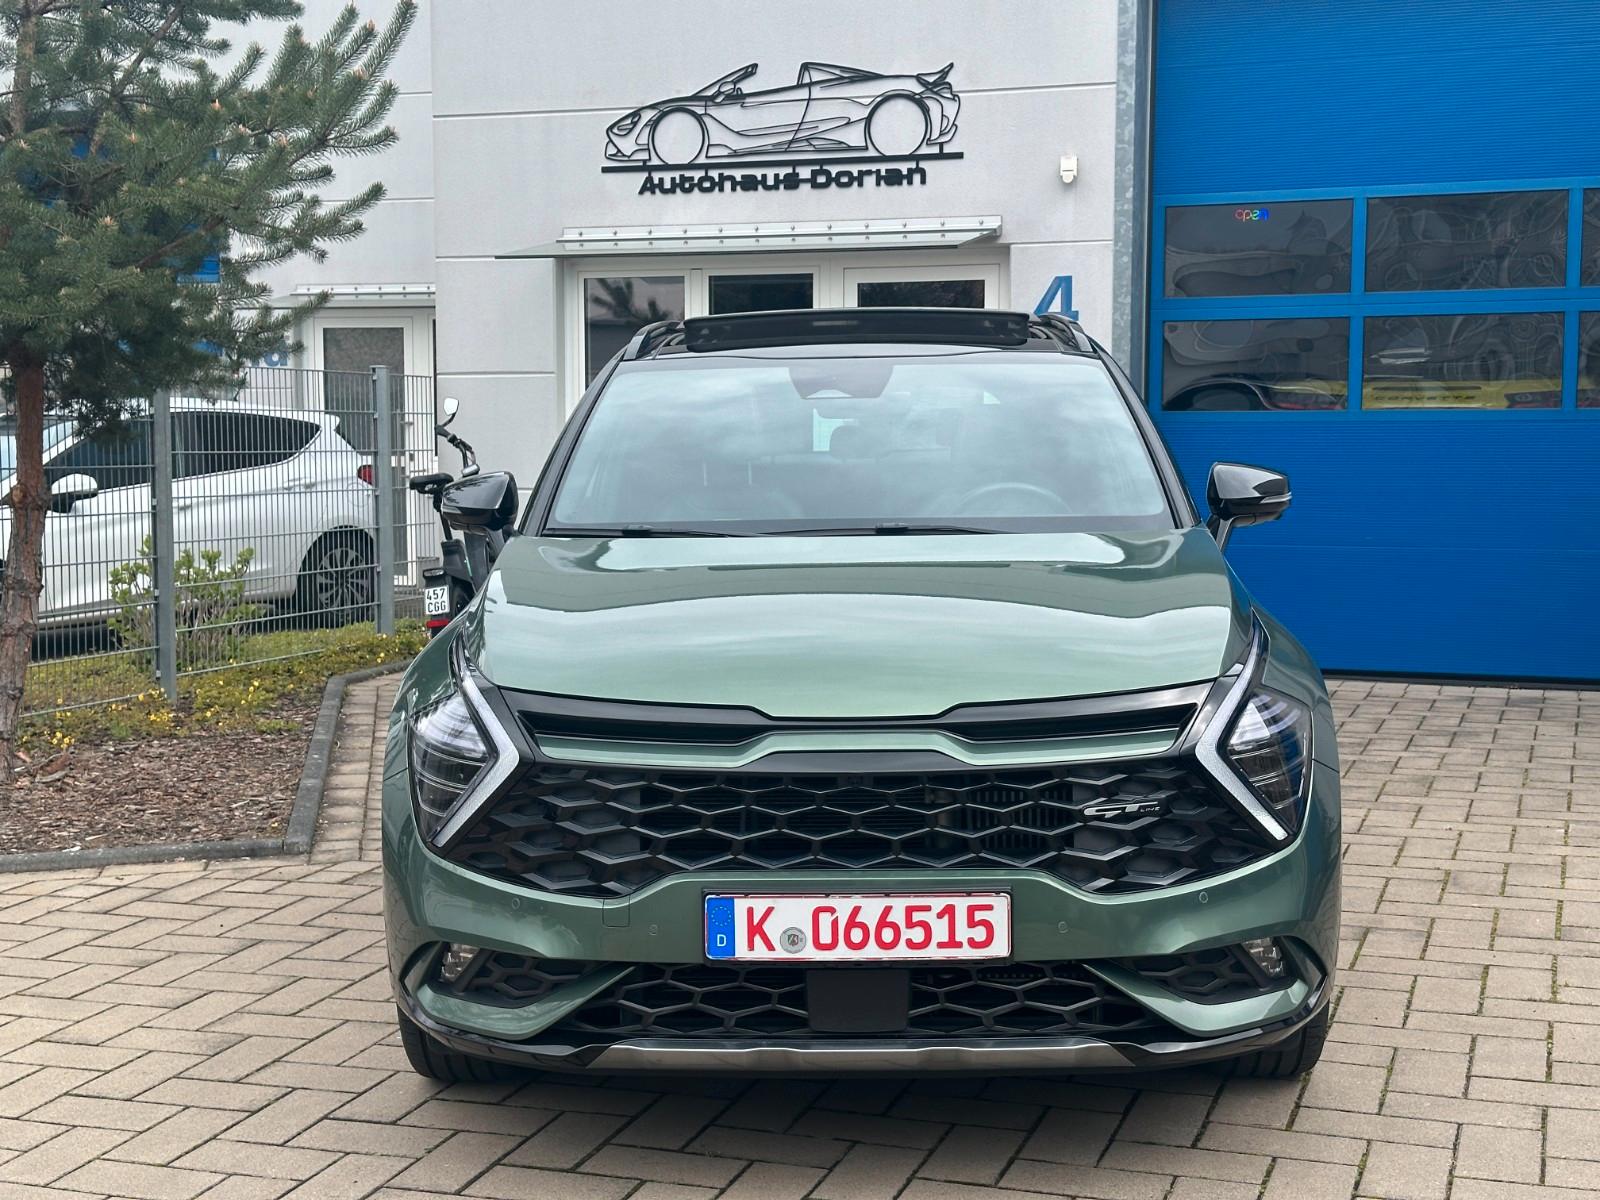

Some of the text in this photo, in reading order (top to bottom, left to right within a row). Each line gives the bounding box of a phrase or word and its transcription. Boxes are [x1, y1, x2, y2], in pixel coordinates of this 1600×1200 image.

[1234, 207, 1269, 222] open
[1033, 275, 1079, 321] 4
[427, 588, 446, 601] 457
[427, 601, 446, 613] CGG
[746, 904, 995, 951] K 066515
[716, 934, 727, 947] D
